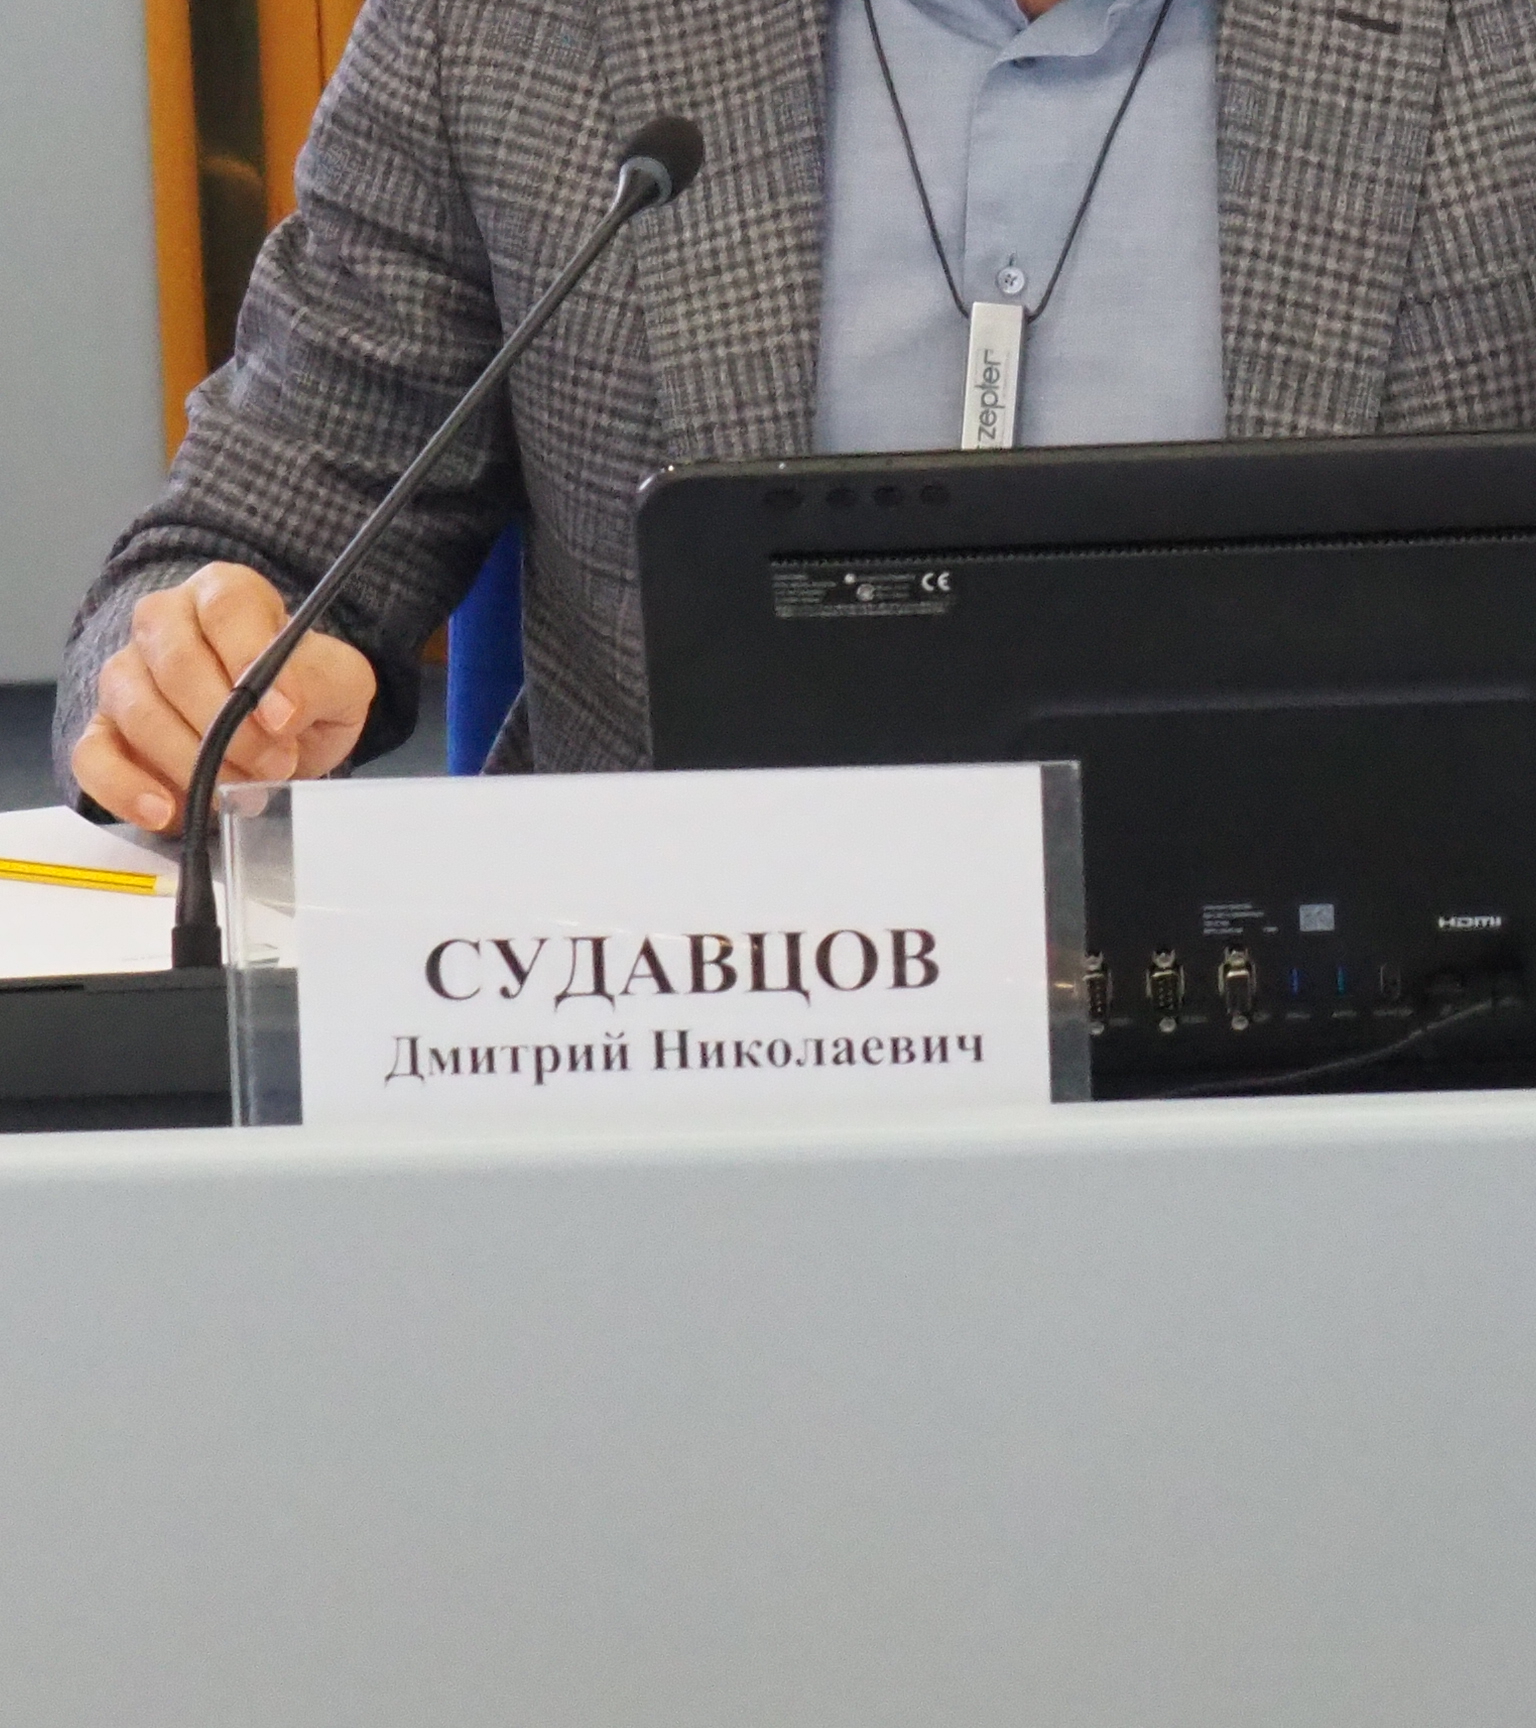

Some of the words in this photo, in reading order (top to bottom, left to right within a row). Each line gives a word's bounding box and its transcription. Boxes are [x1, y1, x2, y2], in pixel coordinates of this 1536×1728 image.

[975, 349, 1005, 442] zepter
[921, 572, 950, 592] CE
[1438, 916, 1502, 929] HDMI
[425, 928, 940, 1010] СУДАВЦОВ
[385, 1032, 630, 1085] Дмитрий
[652, 1030, 985, 1071] Николаевич
